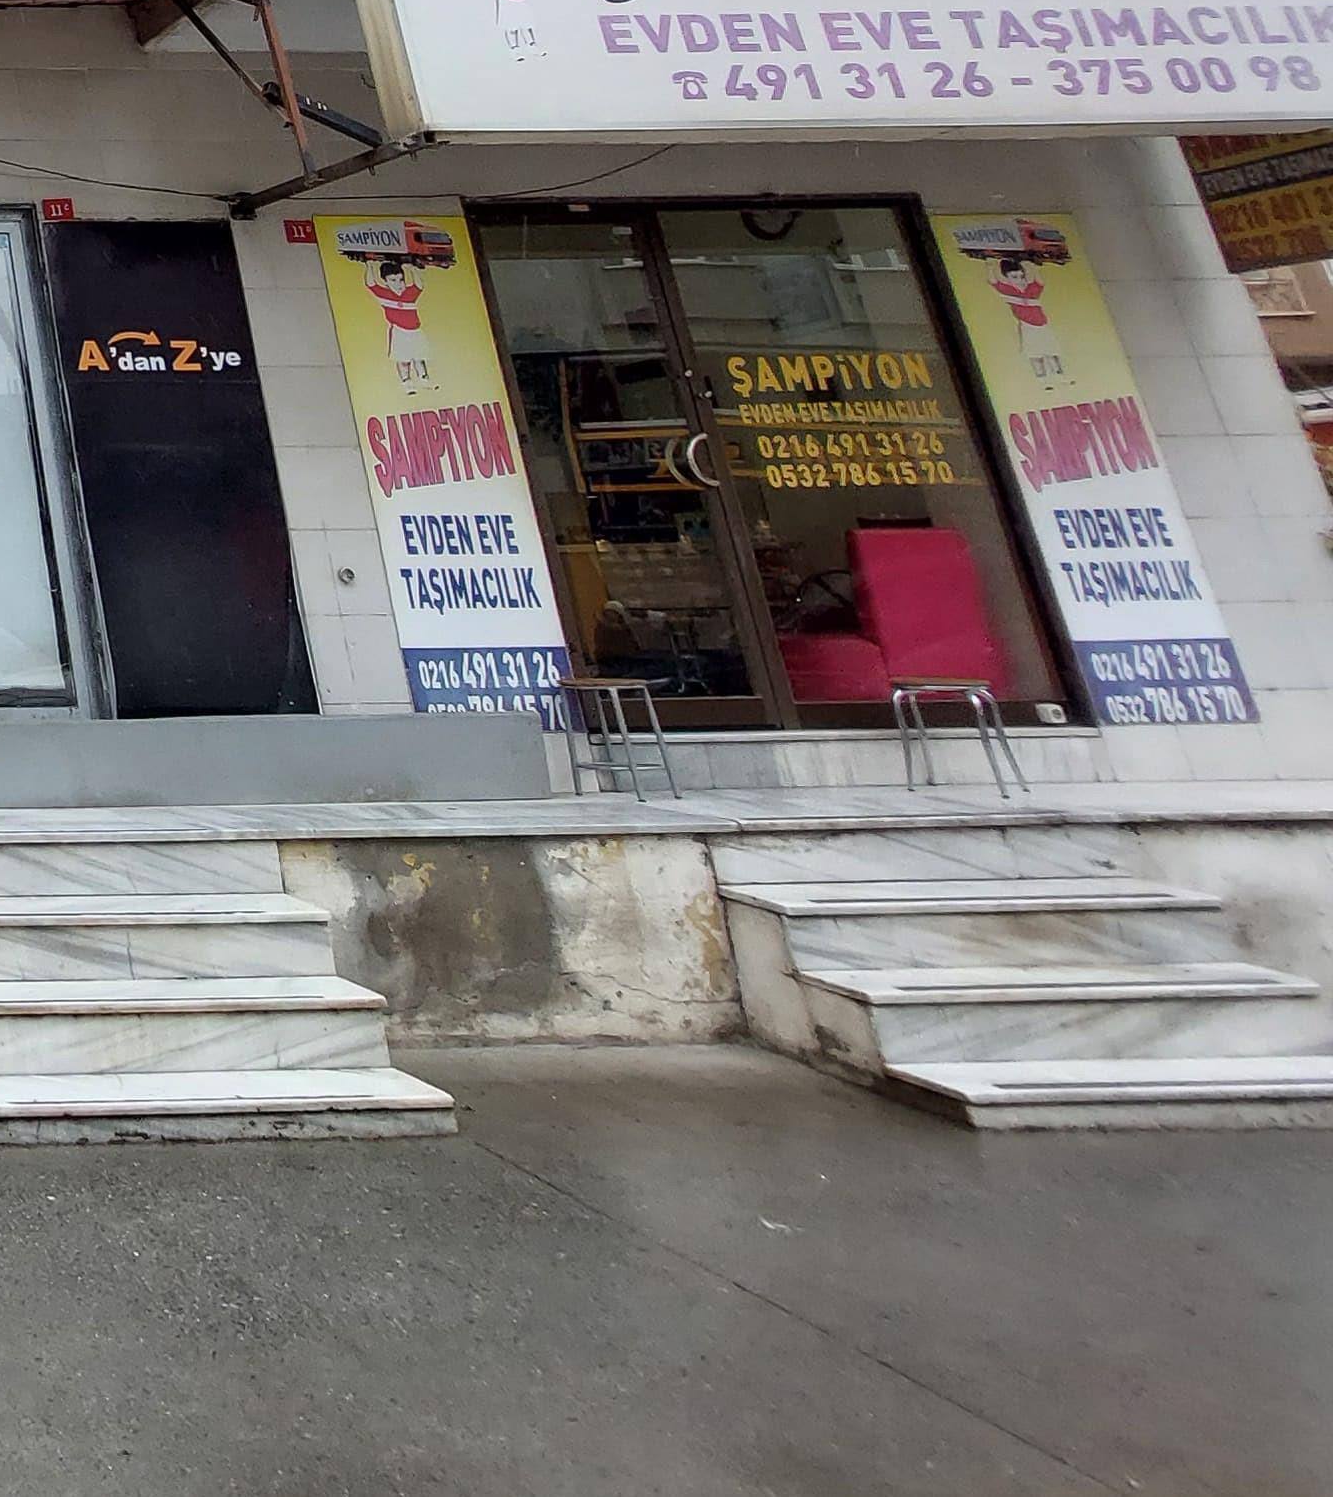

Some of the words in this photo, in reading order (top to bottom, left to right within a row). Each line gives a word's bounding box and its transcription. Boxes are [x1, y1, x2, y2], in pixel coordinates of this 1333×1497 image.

[597, 12, 810, 54] EVDEN
[827, 11, 943, 53] EVE
[947, 5, 1333, 60] TAŞIMACILIK
[723, 61, 820, 102] 491
[839, 59, 901, 100] 31
[930, 59, 994, 99] 26
[1047, 58, 1150, 97] 375
[1167, 58, 1238, 96] 00
[1254, 57, 1320, 94] 98
[739, 403, 797, 425] EVDEN
[799, 402, 832, 423] EVE
[367, 401, 518, 498] ŞAMPİYON
[757, 433, 821, 459] 0216
[826, 432, 871, 457] 491
[875, 431, 907, 456] 31
[911, 430, 945, 455] 26
[1008, 396, 1159, 493] ŞAMPİYON
[766, 464, 831, 489] 0532
[832, 462, 883, 487] 786
[885, 461, 917, 486] 15
[919, 460, 955, 485] 70
[400, 515, 475, 556] EVDEN
[475, 514, 520, 555] EVE
[1053, 507, 1129, 550] EVDEN
[1129, 507, 1174, 548] EVE
[400, 566, 542, 616] TAŞIMACILIK
[1059, 560, 1203, 608] TAŞIMACILIK
[418, 660, 461, 690] 0216
[462, 651, 501, 690] 491
[502, 651, 531, 689] 31
[533, 650, 562, 688] 26
[1091, 652, 1134, 683] 0216
[1133, 644, 1172, 681] 491
[1172, 642, 1199, 680] 31
[1199, 642, 1230, 678] 26
[1107, 694, 1147, 724] 0532
[1146, 686, 1186, 723] 786
[1187, 687, 1217, 722] 15
[1217, 686, 1246, 721] 70
